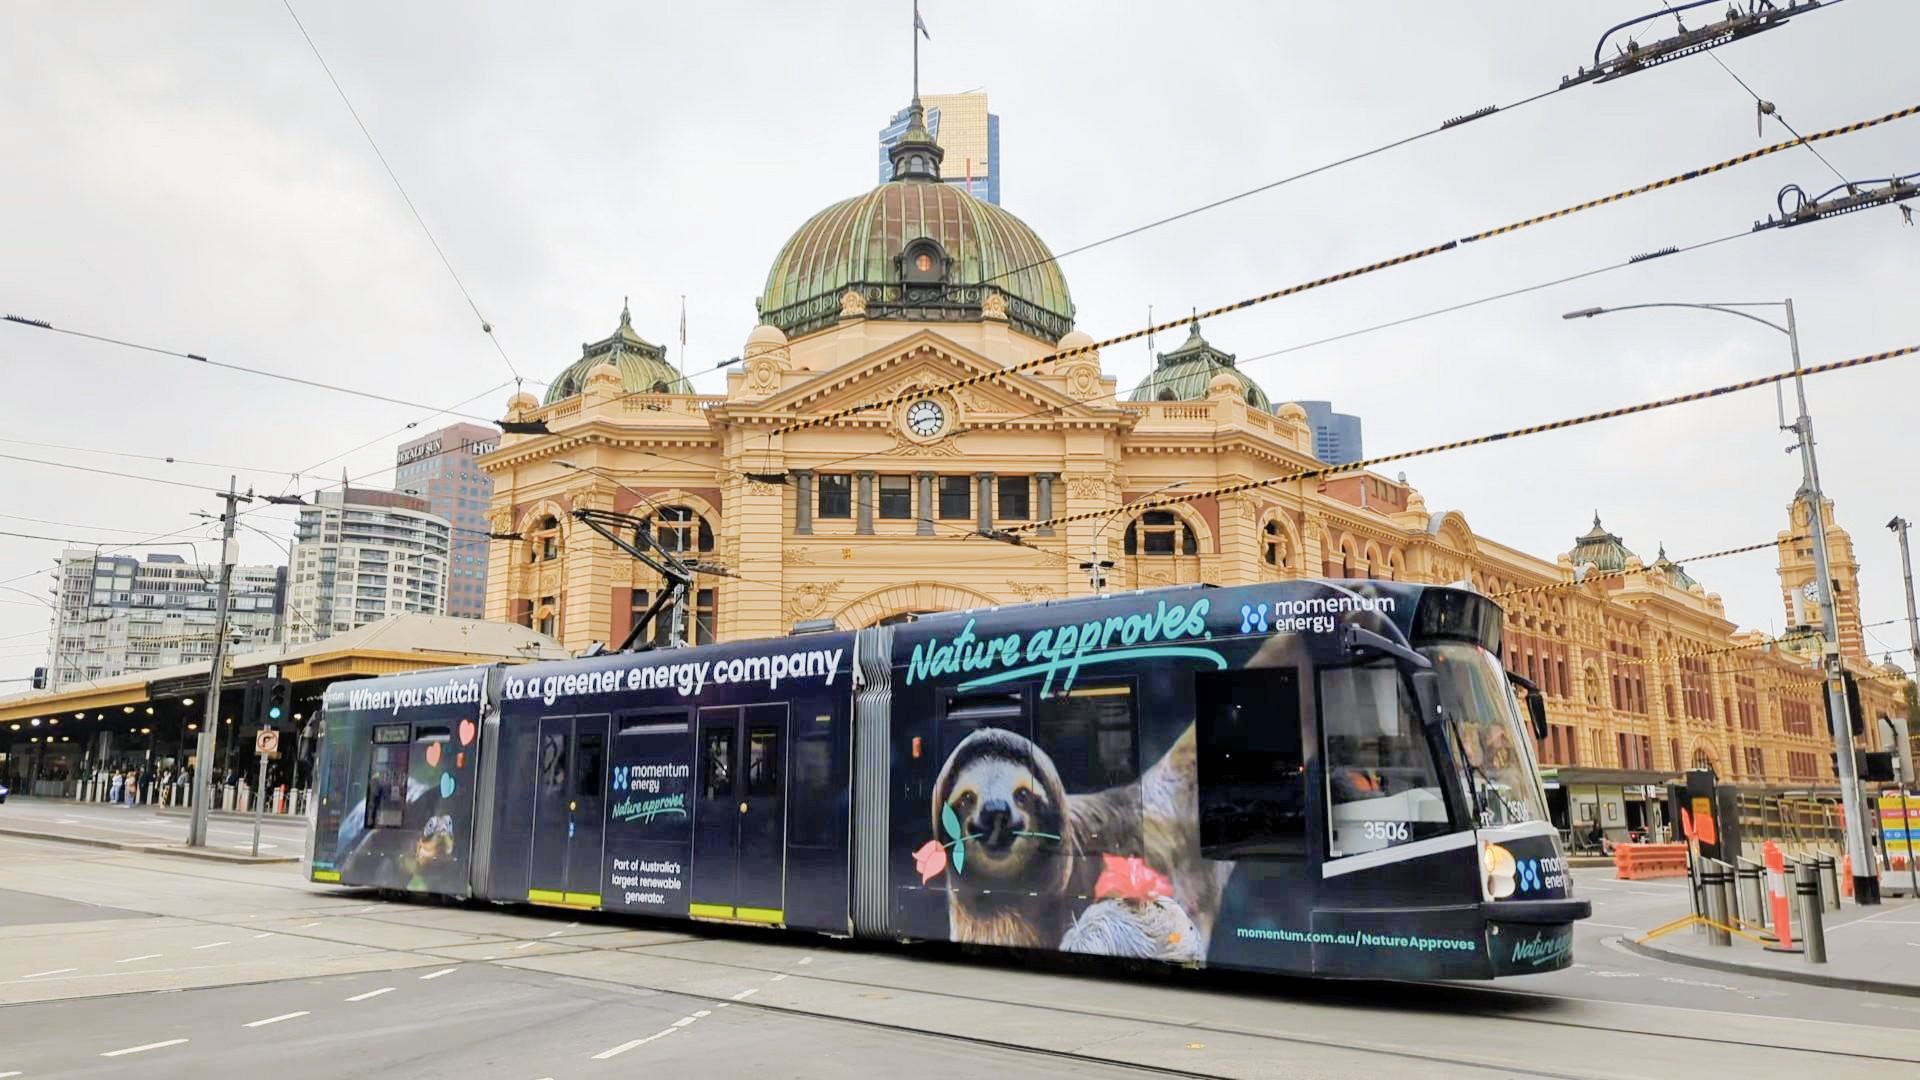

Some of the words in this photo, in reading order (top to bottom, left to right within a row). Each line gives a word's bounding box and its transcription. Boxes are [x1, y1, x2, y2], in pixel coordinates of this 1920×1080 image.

[1275, 596, 1395, 615] momentum
[1275, 615, 1335, 633] energy
[906, 618, 1020, 685] Nature
[350, 688, 390, 711] When
[392, 688, 421, 715] you
[425, 678, 479, 705] switch
[505, 675, 524, 699] to
[527, 677, 541, 696] a
[543, 669, 621, 705] greener
[627, 661, 710, 696] energy
[713, 648, 843, 689] company
[631, 763, 689, 778] momentum
[631, 780, 660, 793] energy
[612, 797, 641, 819] Nature
[1363, 821, 1408, 840] 3506
[613, 859, 629, 871] Part
[630, 860, 638, 871] of
[640, 861, 681, 874] Australia's
[612, 874, 638, 888] largest
[640, 877, 681, 890] renewable
[625, 891, 665, 904] generator.
[1237, 927, 1475, 951] momentum.com.au/NatureApproves
